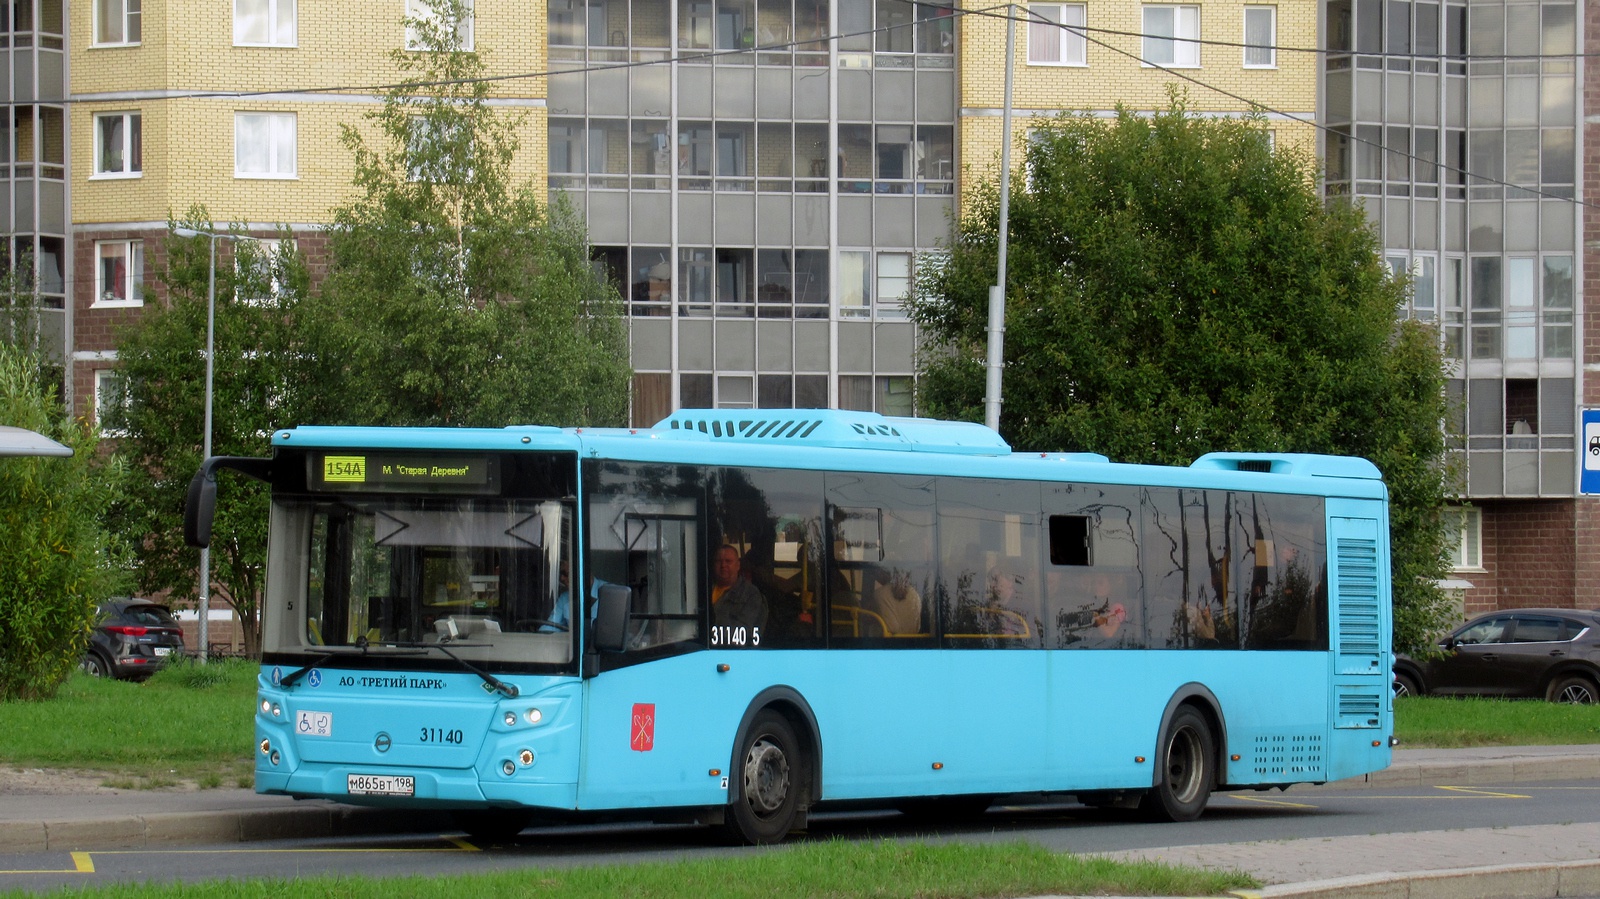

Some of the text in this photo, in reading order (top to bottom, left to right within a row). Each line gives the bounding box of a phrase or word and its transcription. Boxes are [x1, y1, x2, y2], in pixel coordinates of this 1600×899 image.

[327, 462, 362, 476] 154А
[711, 625, 760, 646] 31140 5
[339, 675, 447, 689] АО «ТРЕТИЙ ПАРК»
[420, 727, 463, 744] 31140
[395, 777, 411, 788] 198
